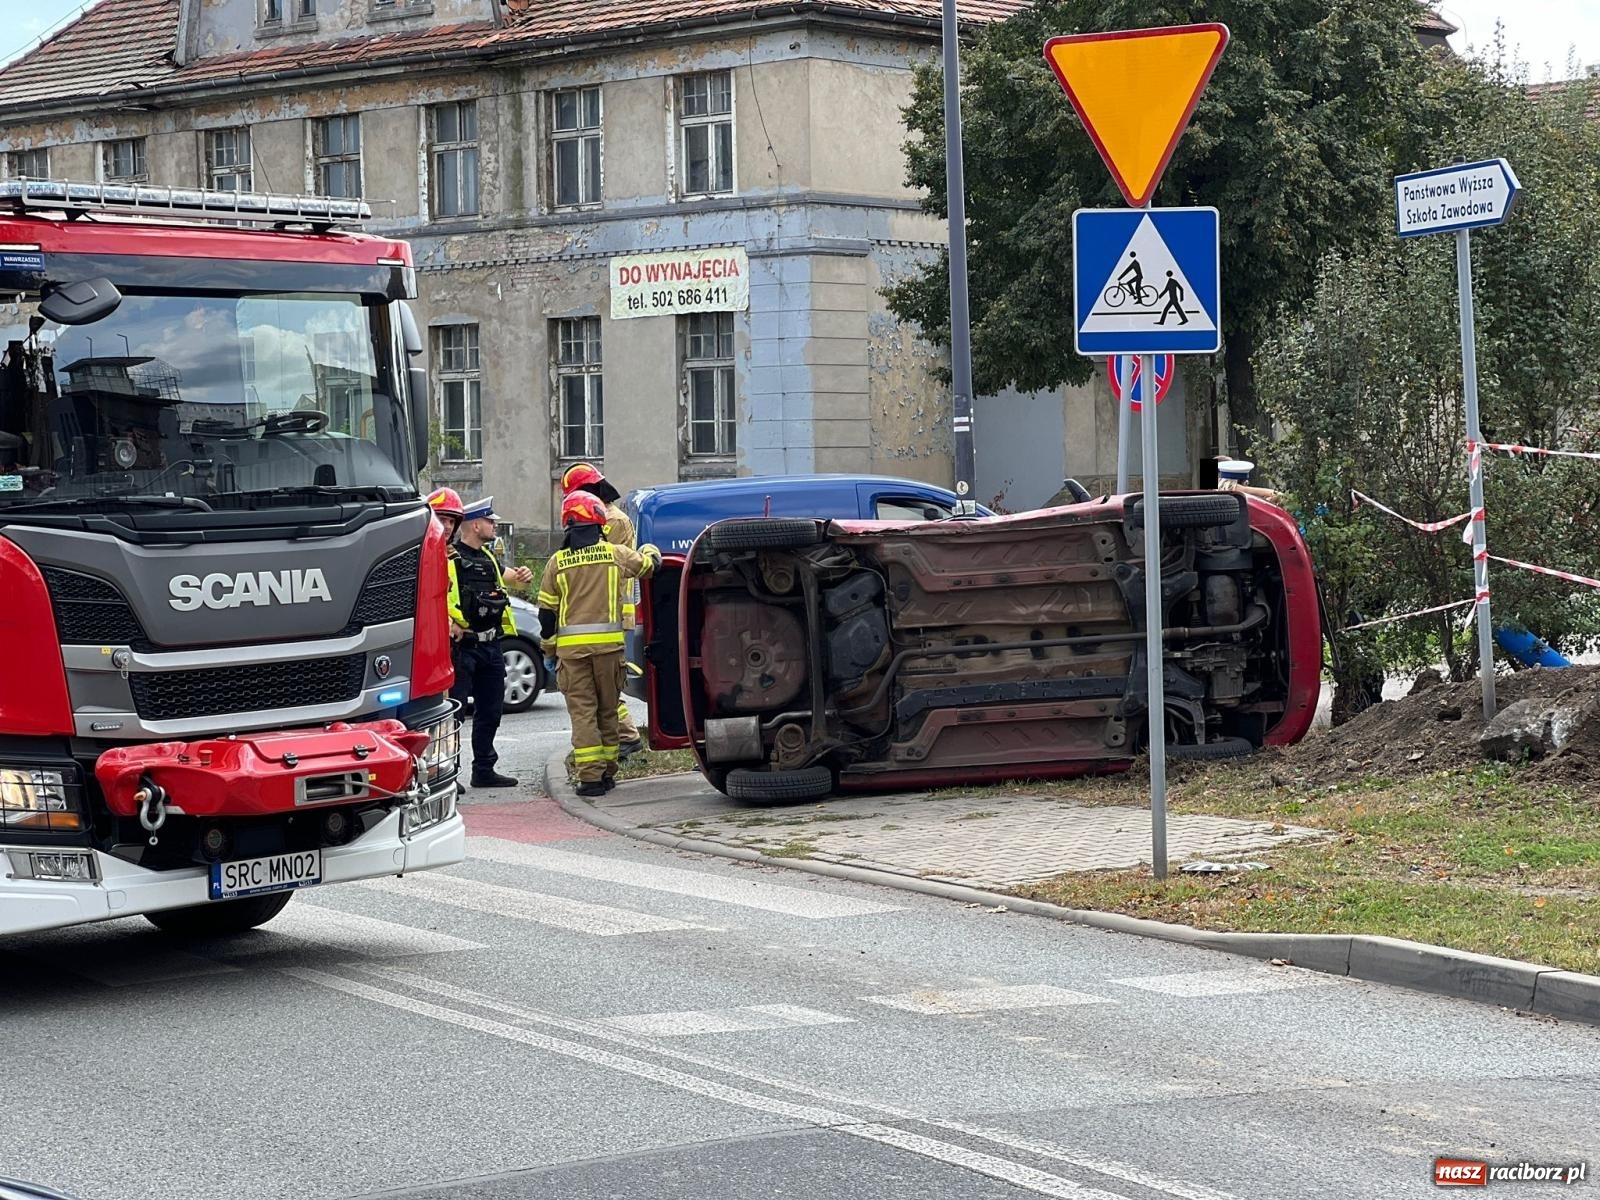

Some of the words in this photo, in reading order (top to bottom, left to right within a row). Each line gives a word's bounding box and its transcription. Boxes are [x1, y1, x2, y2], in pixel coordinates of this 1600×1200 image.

[1404, 183, 1456, 202] Państwowa
[1458, 175, 1494, 196] Wyższa
[1406, 206, 1438, 225] Szkoła
[1440, 200, 1493, 219] Zawodowa
[619, 265, 642, 286] DO
[646, 258, 740, 283] WYNAJĘCIA
[627, 292, 648, 310] tel.
[652, 290, 673, 308] 502
[678, 288, 701, 306] 686
[705, 286, 728, 304] 411
[168, 568, 332, 612] SCANIA
[225, 860, 262, 889] SRC
[269, 853, 315, 883] MN02
[213, 882, 220, 890] PL
